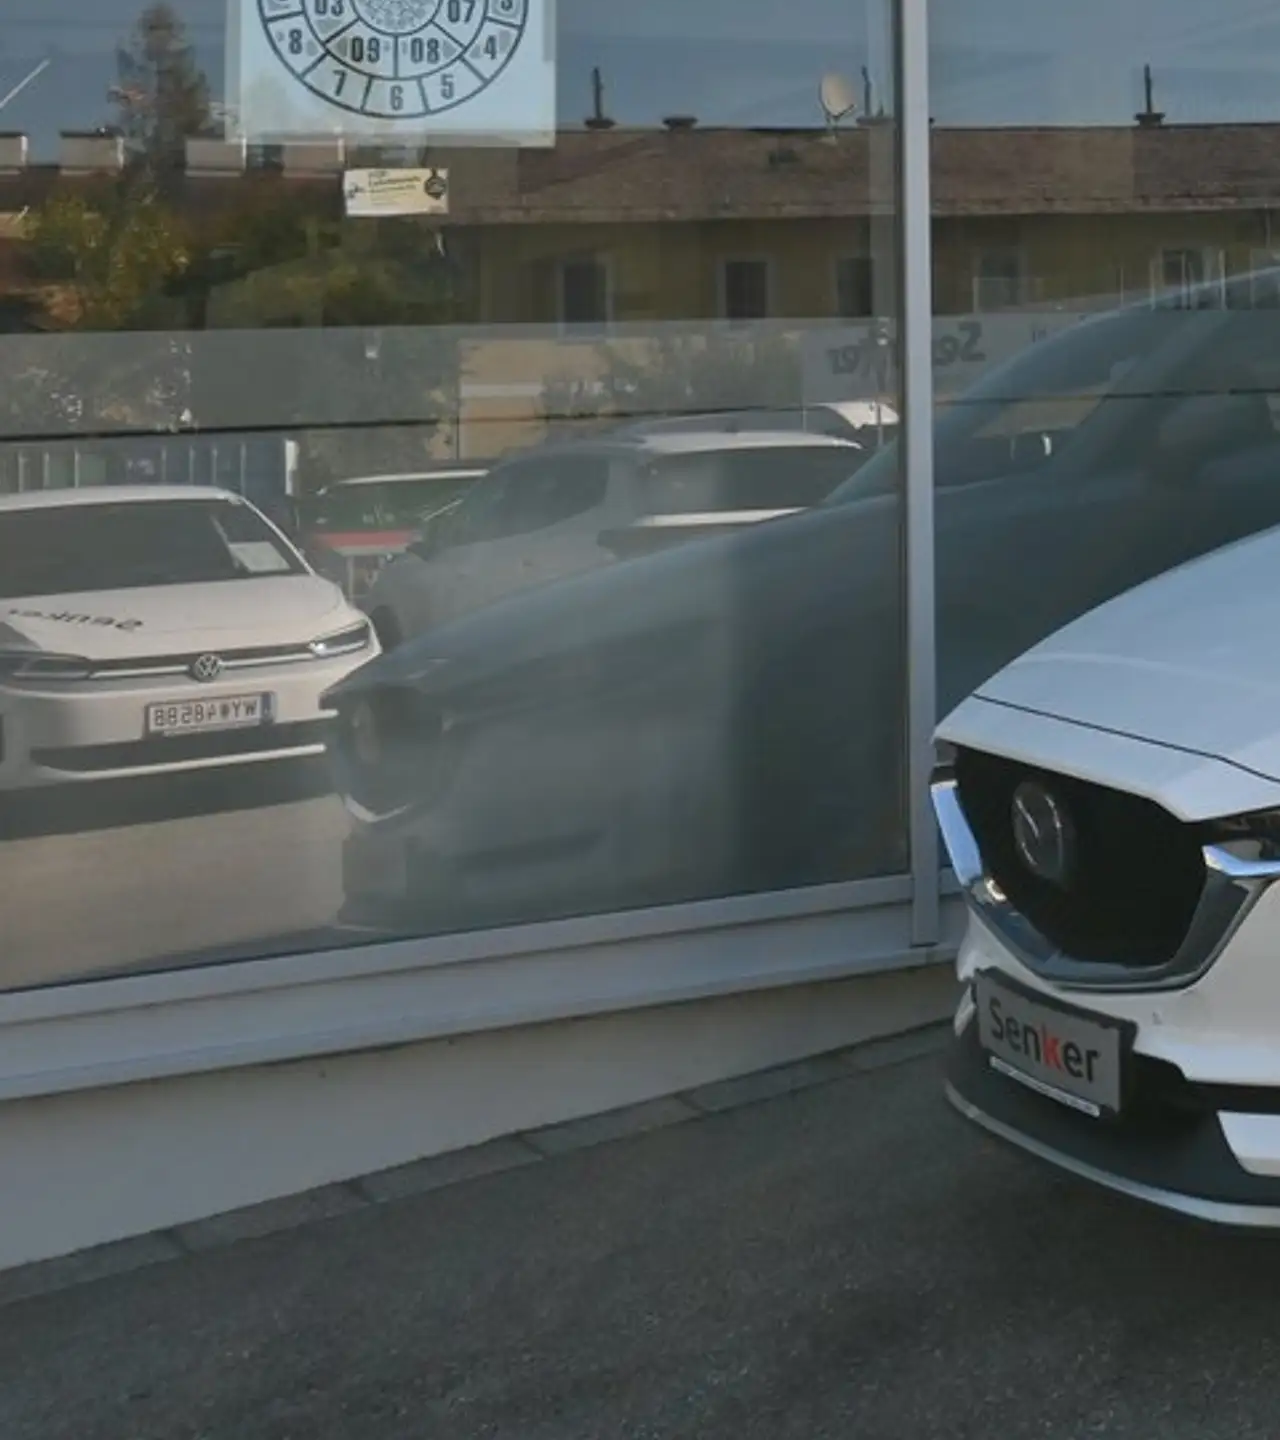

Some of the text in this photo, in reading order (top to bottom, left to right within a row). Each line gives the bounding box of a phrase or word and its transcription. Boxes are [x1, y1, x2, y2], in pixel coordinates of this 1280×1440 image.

[288, 29, 303, 55] 8
[351, 37, 381, 63] 09
[410, 37, 440, 64] 08
[482, 34, 497, 60] 4
[332, 69, 347, 96] 7
[440, 73, 454, 100] 5
[390, 84, 404, 111] 6
[989, 996, 1101, 1083] Senker
